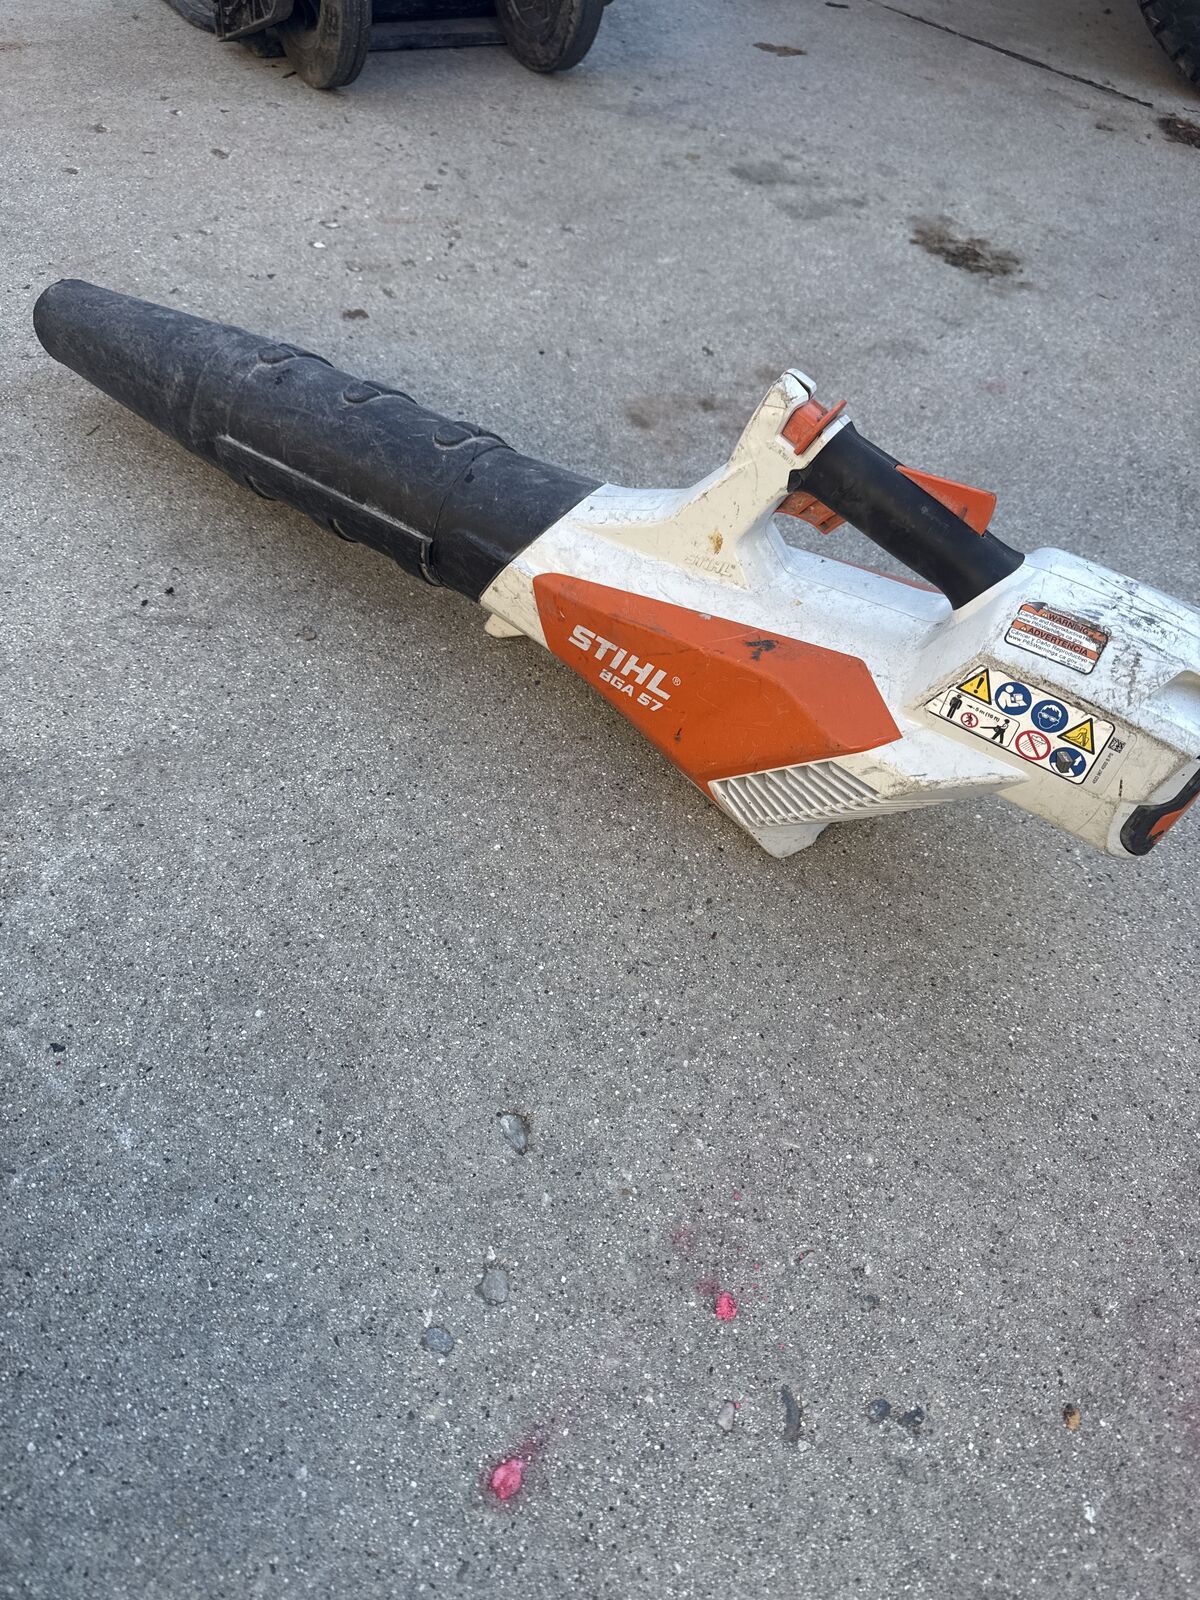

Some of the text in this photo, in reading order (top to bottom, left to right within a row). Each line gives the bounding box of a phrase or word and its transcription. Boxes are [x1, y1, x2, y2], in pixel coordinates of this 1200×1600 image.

[1021, 611, 1038, 621] Cancer
[1048, 622, 1082, 639] Reproductive
[1047, 613, 1089, 634] WARNING
[1027, 626, 1089, 656] ADVERTENCIA
[1051, 645, 1087, 663] Reproductivo
[599, 669, 664, 711] BGA 57
